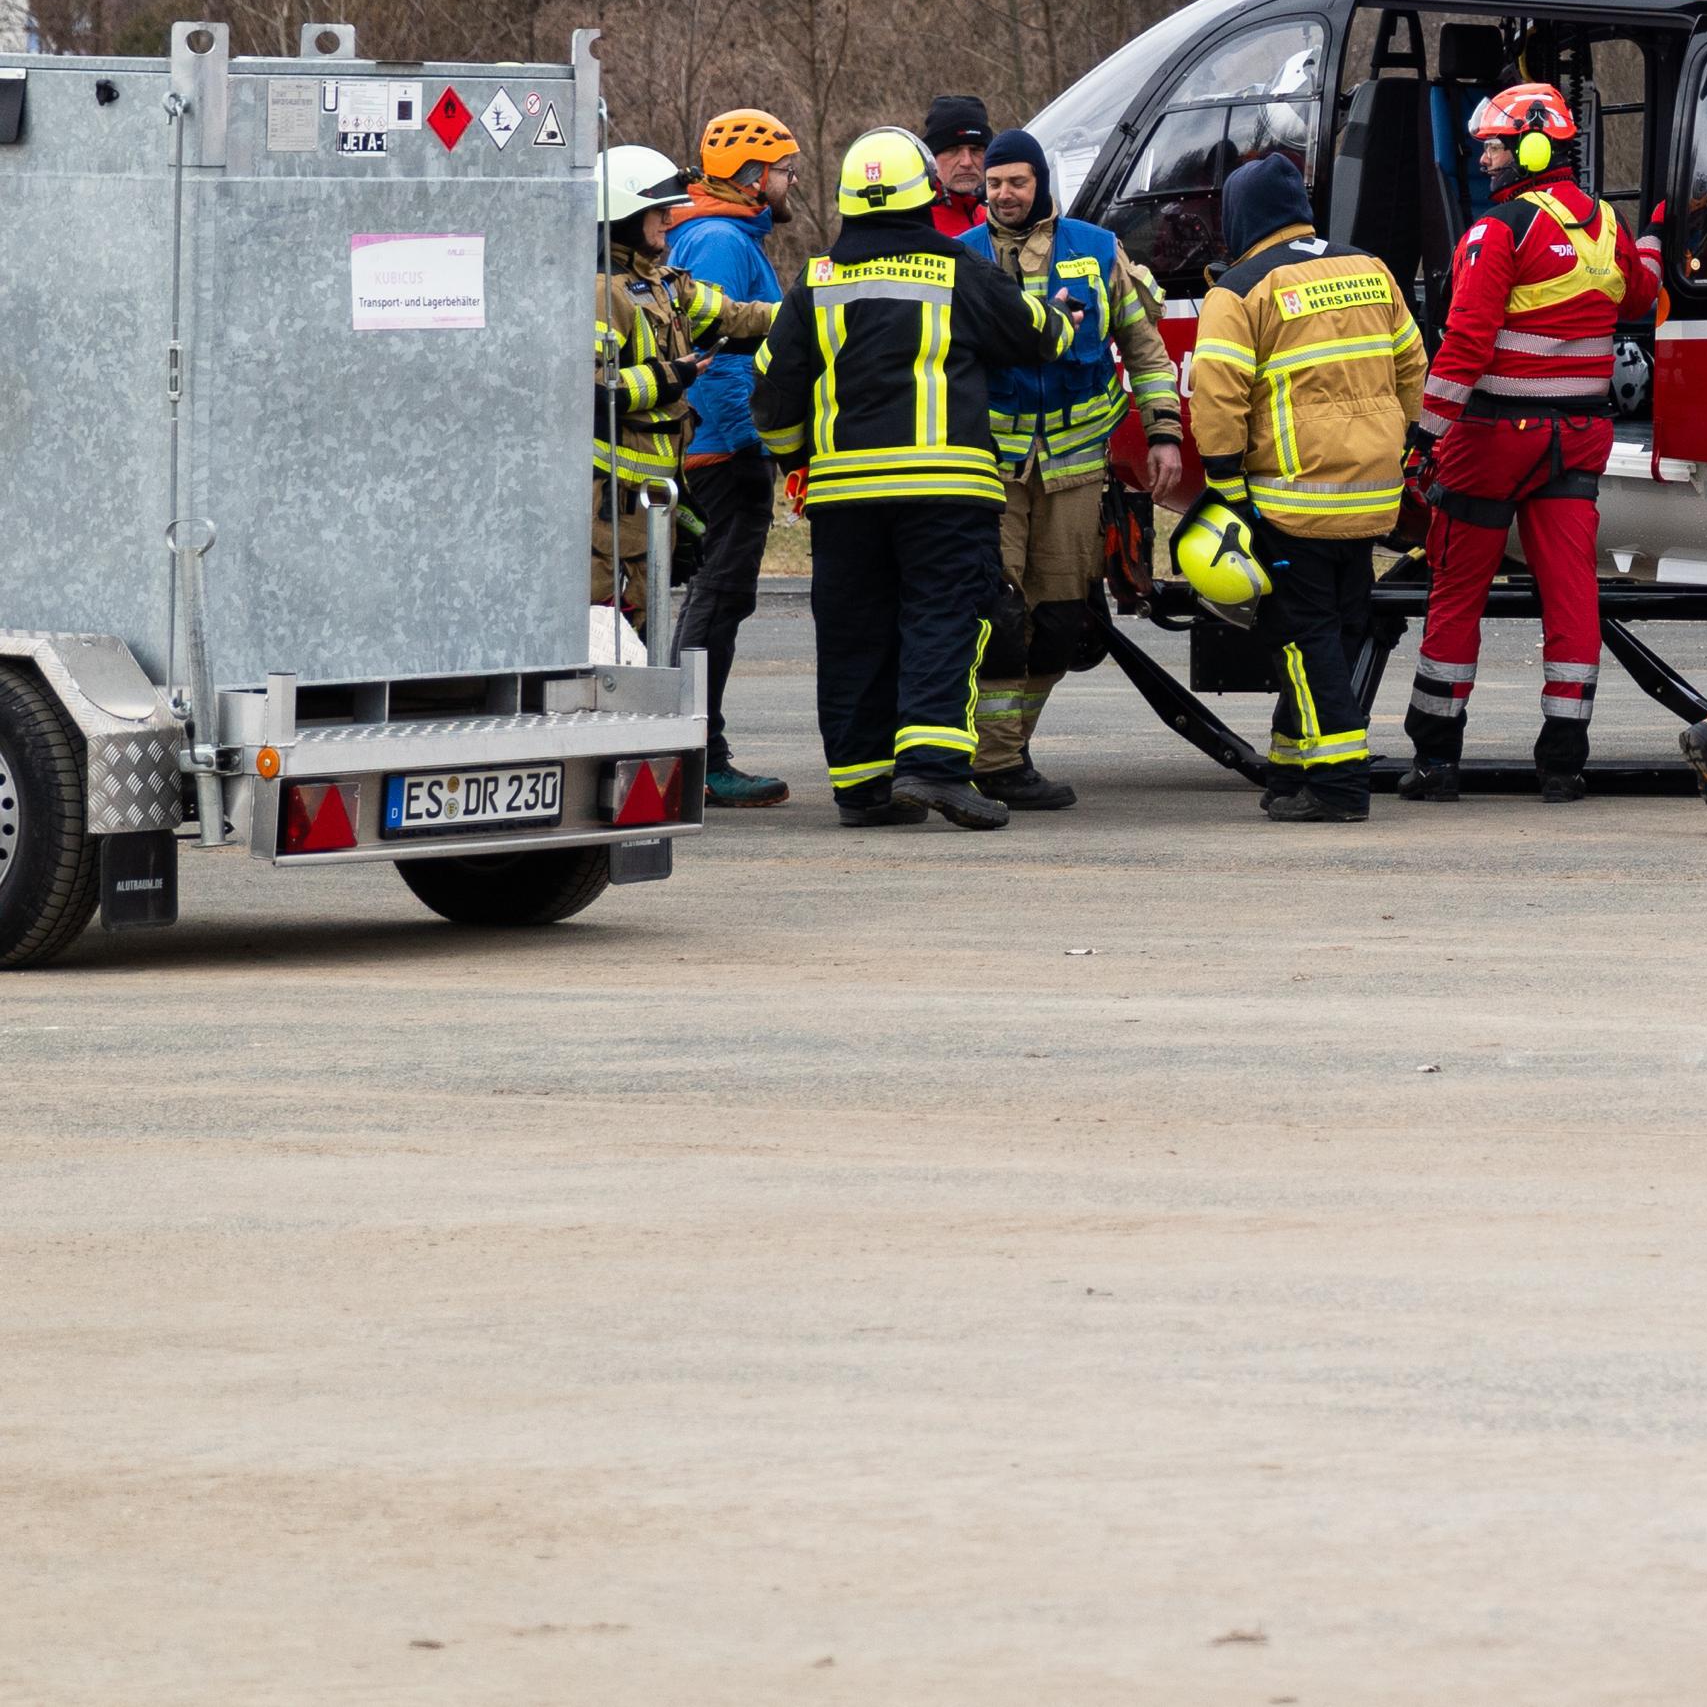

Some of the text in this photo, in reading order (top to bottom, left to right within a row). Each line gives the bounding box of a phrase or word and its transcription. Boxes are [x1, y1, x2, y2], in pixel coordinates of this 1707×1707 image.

[343, 133, 387, 151] JET A-1
[374, 271, 424, 285] KUBICUS
[842, 266, 947, 282] HERSBRUCK
[1305, 277, 1382, 297] FEUERWEHR
[359, 296, 481, 310] Transport- und Lagerbehälter
[1309, 290, 1388, 309] HERSBRUCK
[391, 771, 558, 820] D ES DR 230
